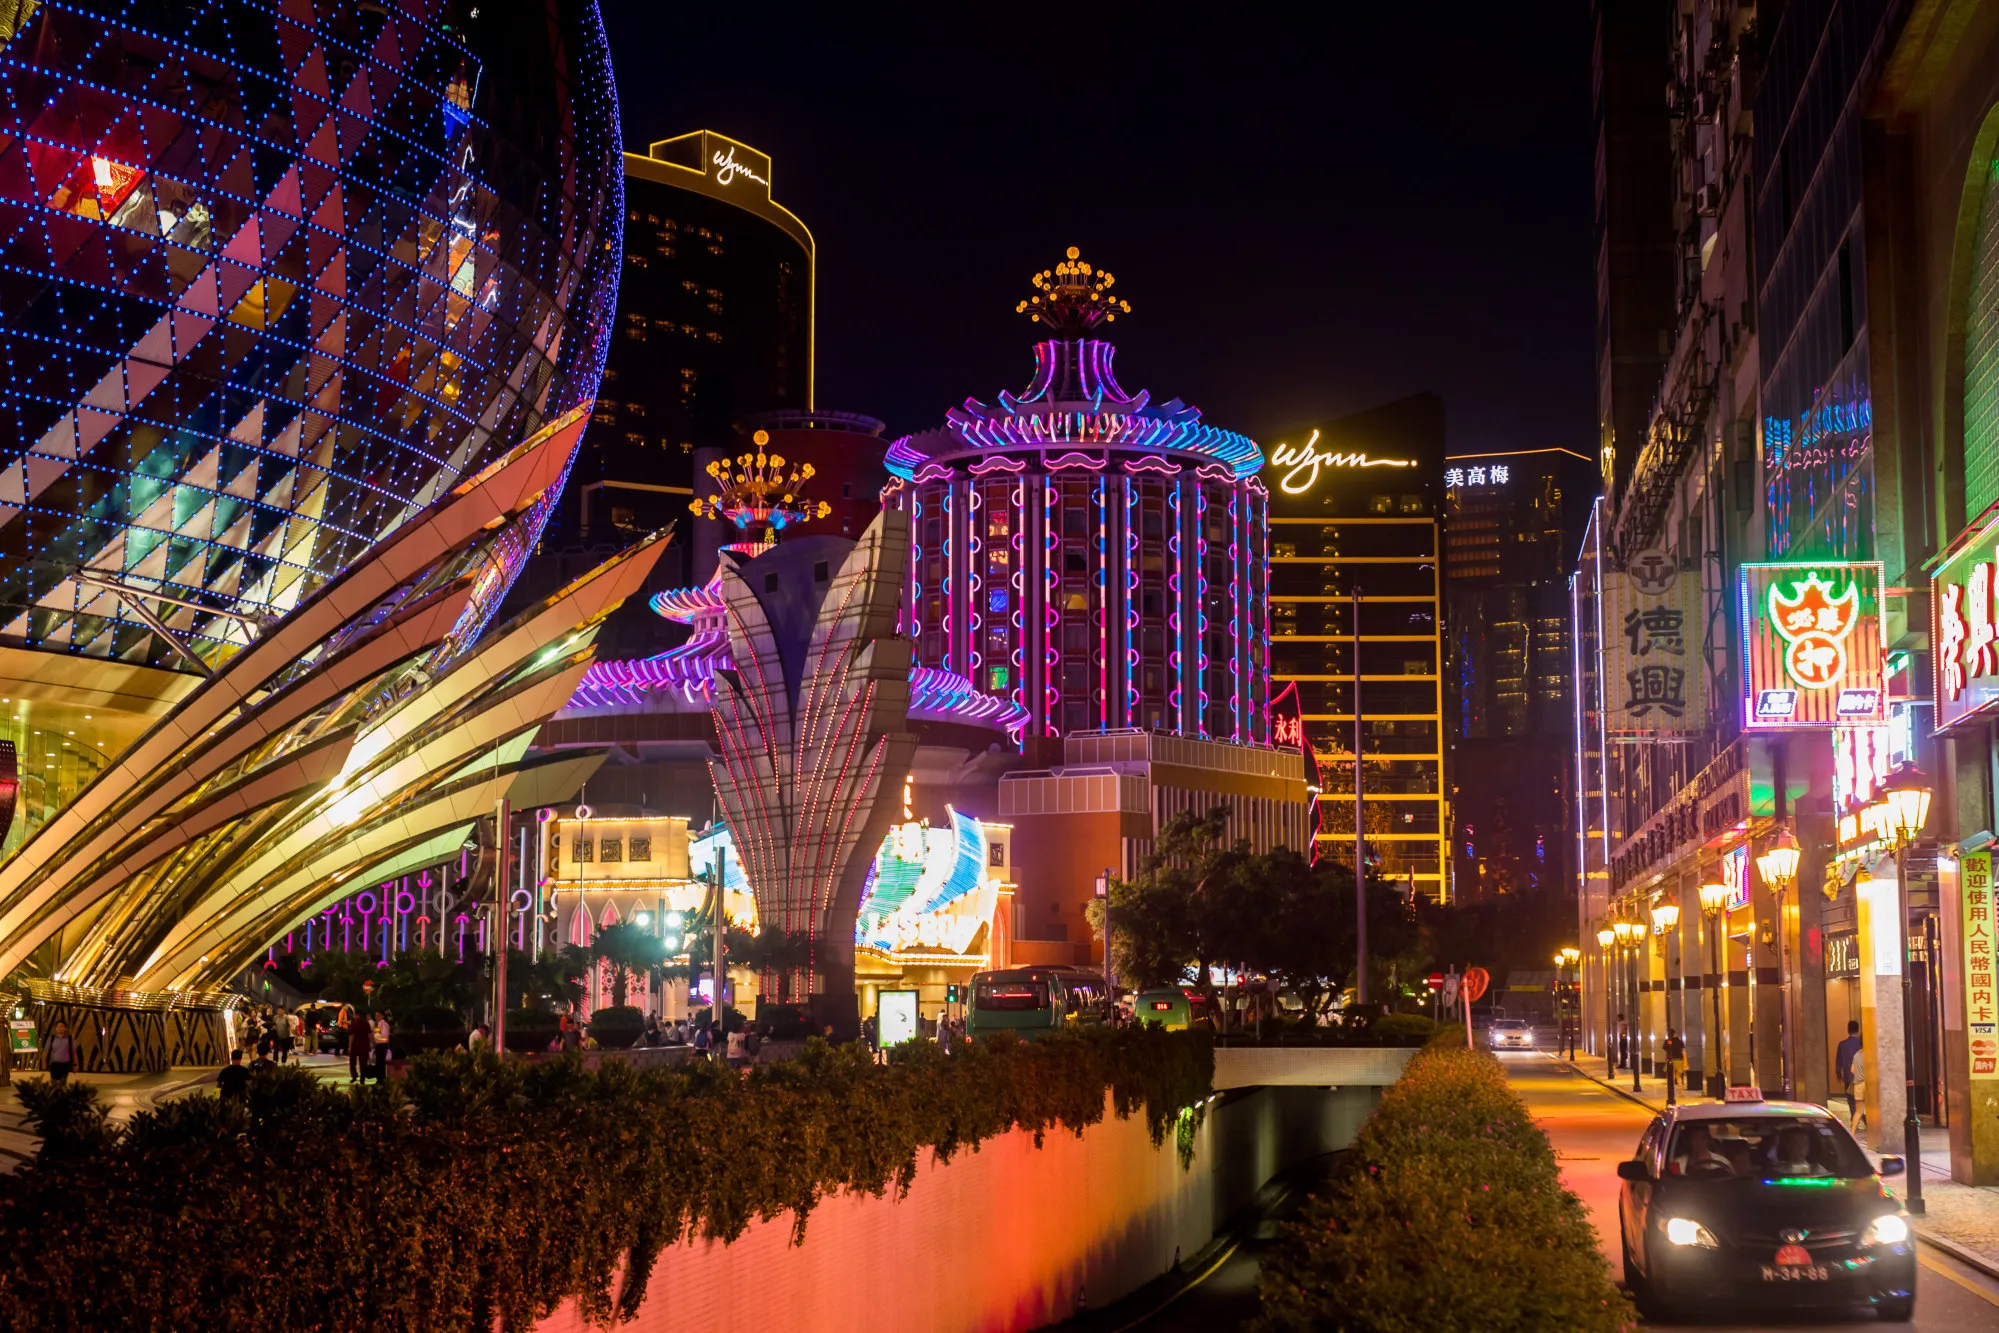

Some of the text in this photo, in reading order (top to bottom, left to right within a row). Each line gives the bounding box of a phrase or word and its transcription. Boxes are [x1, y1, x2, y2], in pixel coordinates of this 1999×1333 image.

[1446, 465, 1510, 488] 美高梅
[1624, 604, 1686, 718] 德興
[1796, 639, 1837, 680] 押
[1274, 713, 1303, 747] 永利
[1729, 1089, 1760, 1100] TAXI
